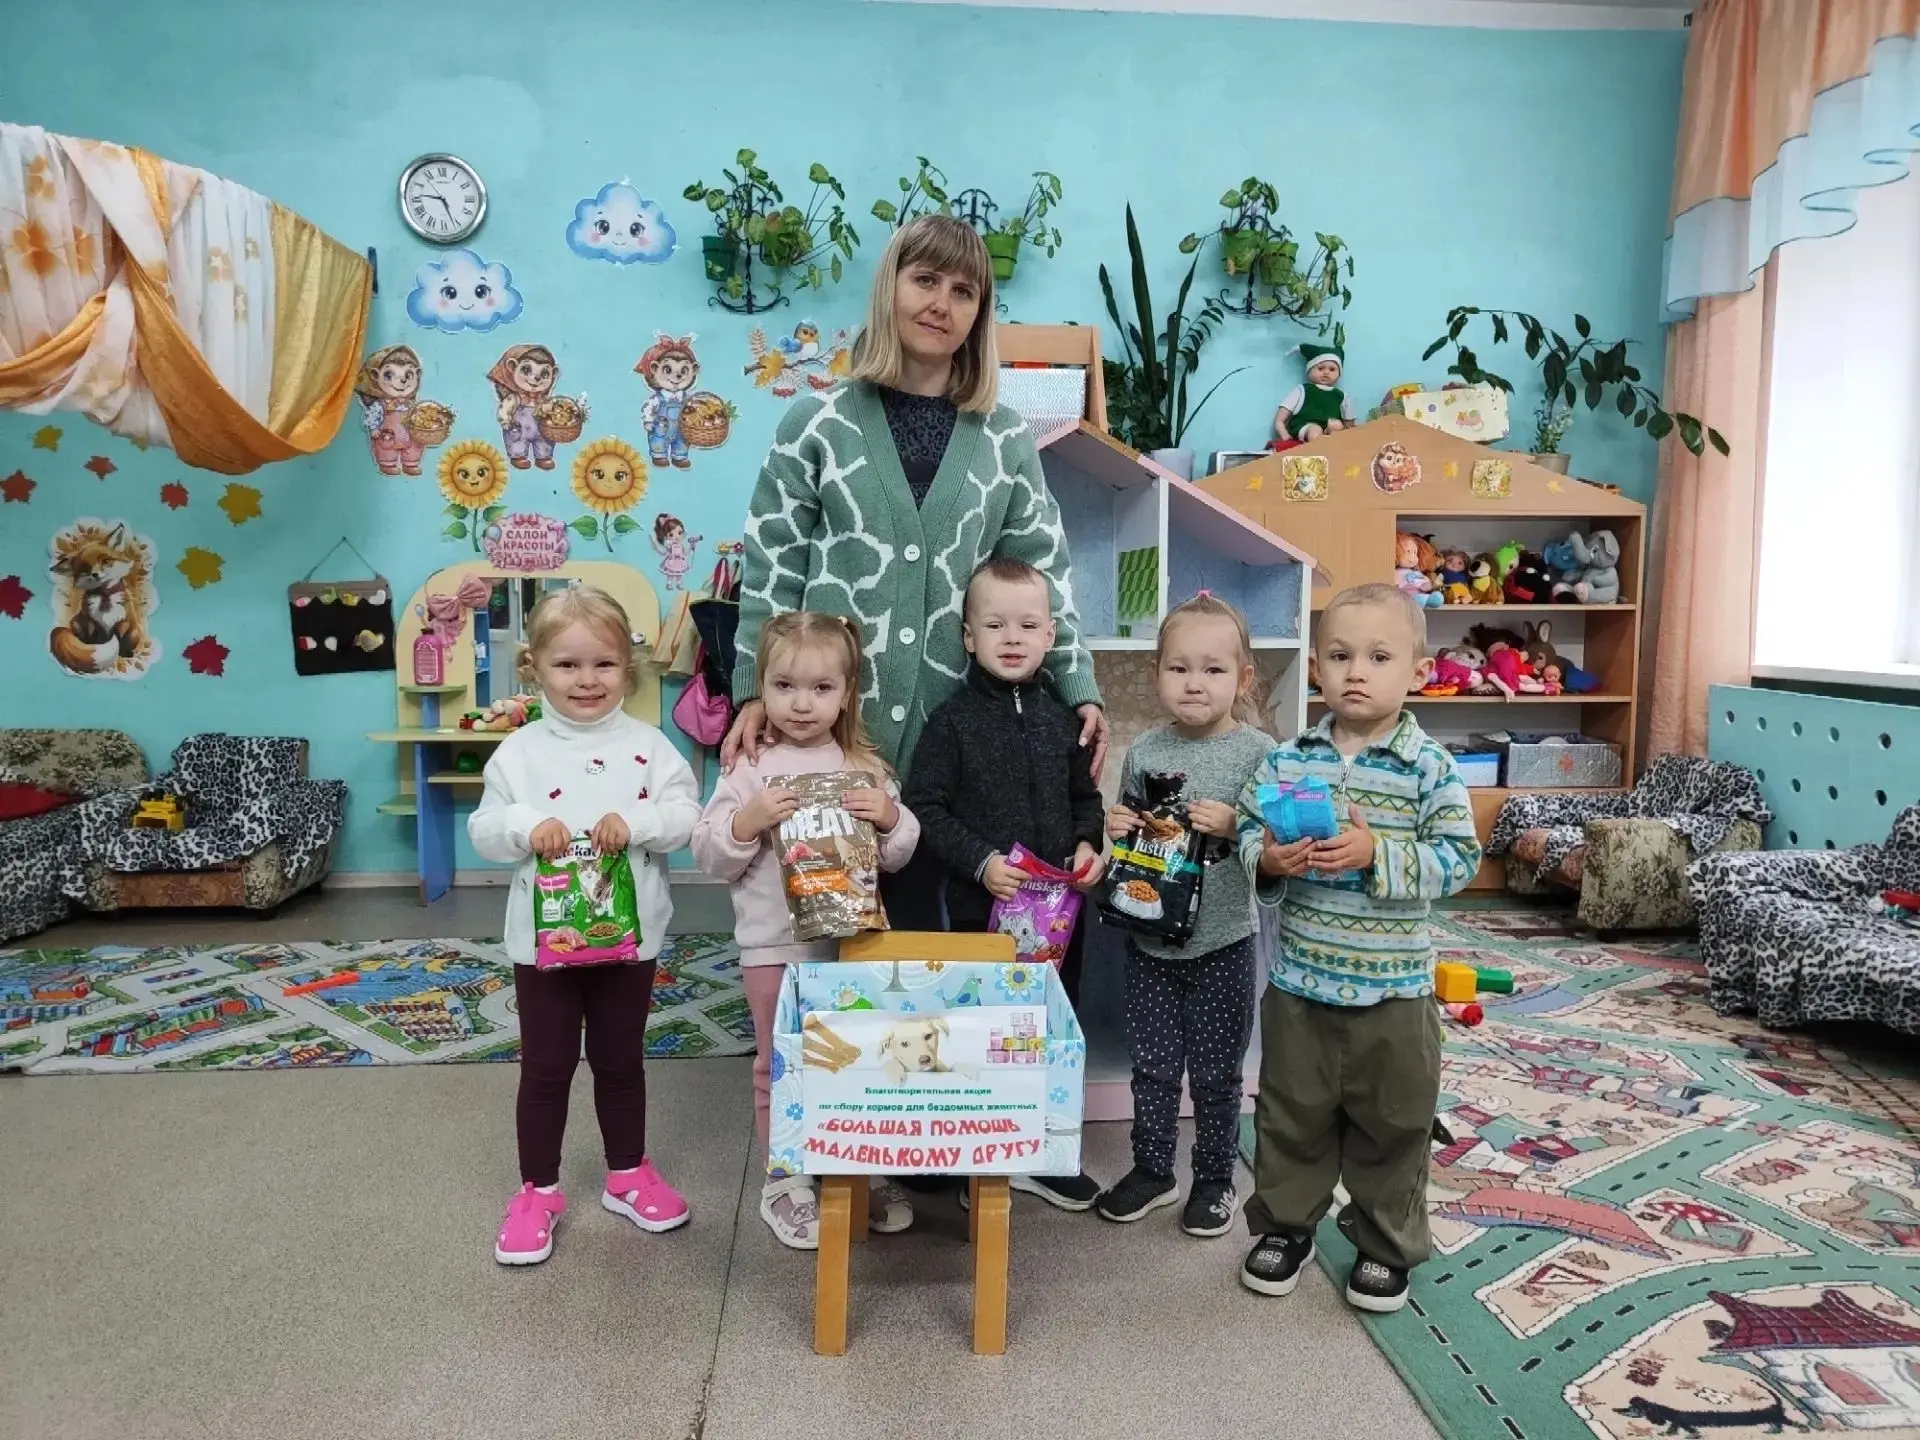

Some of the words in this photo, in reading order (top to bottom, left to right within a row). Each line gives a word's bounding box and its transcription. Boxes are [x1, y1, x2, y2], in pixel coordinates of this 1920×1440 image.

[506, 530, 548, 540] САЛОН
[503, 541, 554, 551] КРАСОТЫ
[781, 806, 855, 841] MEAT
[865, 1087, 961, 1096] Благотворительная
[833, 1102, 864, 1112] сбору
[866, 1104, 903, 1112] кормов
[905, 1104, 925, 1112] для
[926, 1102, 984, 1112] бездомных
[987, 1103, 1037, 1111] животных
[817, 1118, 922, 1137] «БОЛЬШАЯ
[803, 1137, 961, 1168] МАЛЕНЬКОМУ
[972, 1139, 1040, 1166] ДРУГУ
